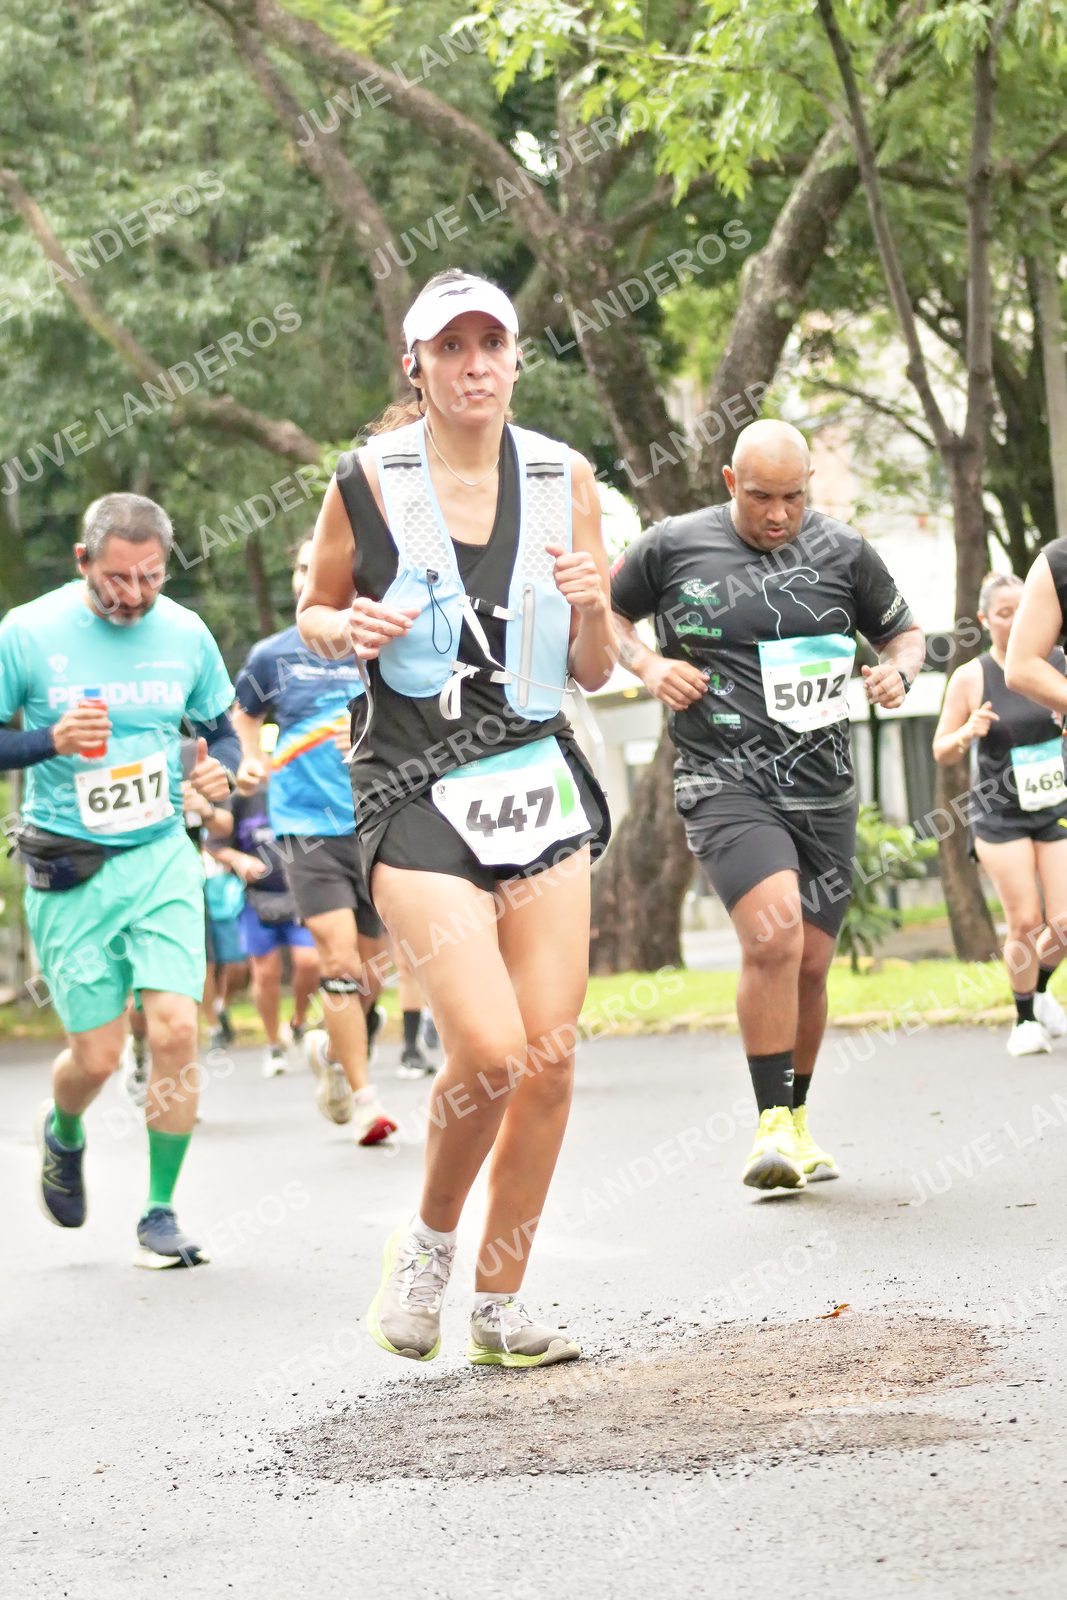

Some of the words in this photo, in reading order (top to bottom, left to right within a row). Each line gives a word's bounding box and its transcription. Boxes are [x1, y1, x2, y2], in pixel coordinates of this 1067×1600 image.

[773, 673, 847, 711] 5012
[88, 771, 163, 813] 6217
[466, 786, 555, 838] 447
